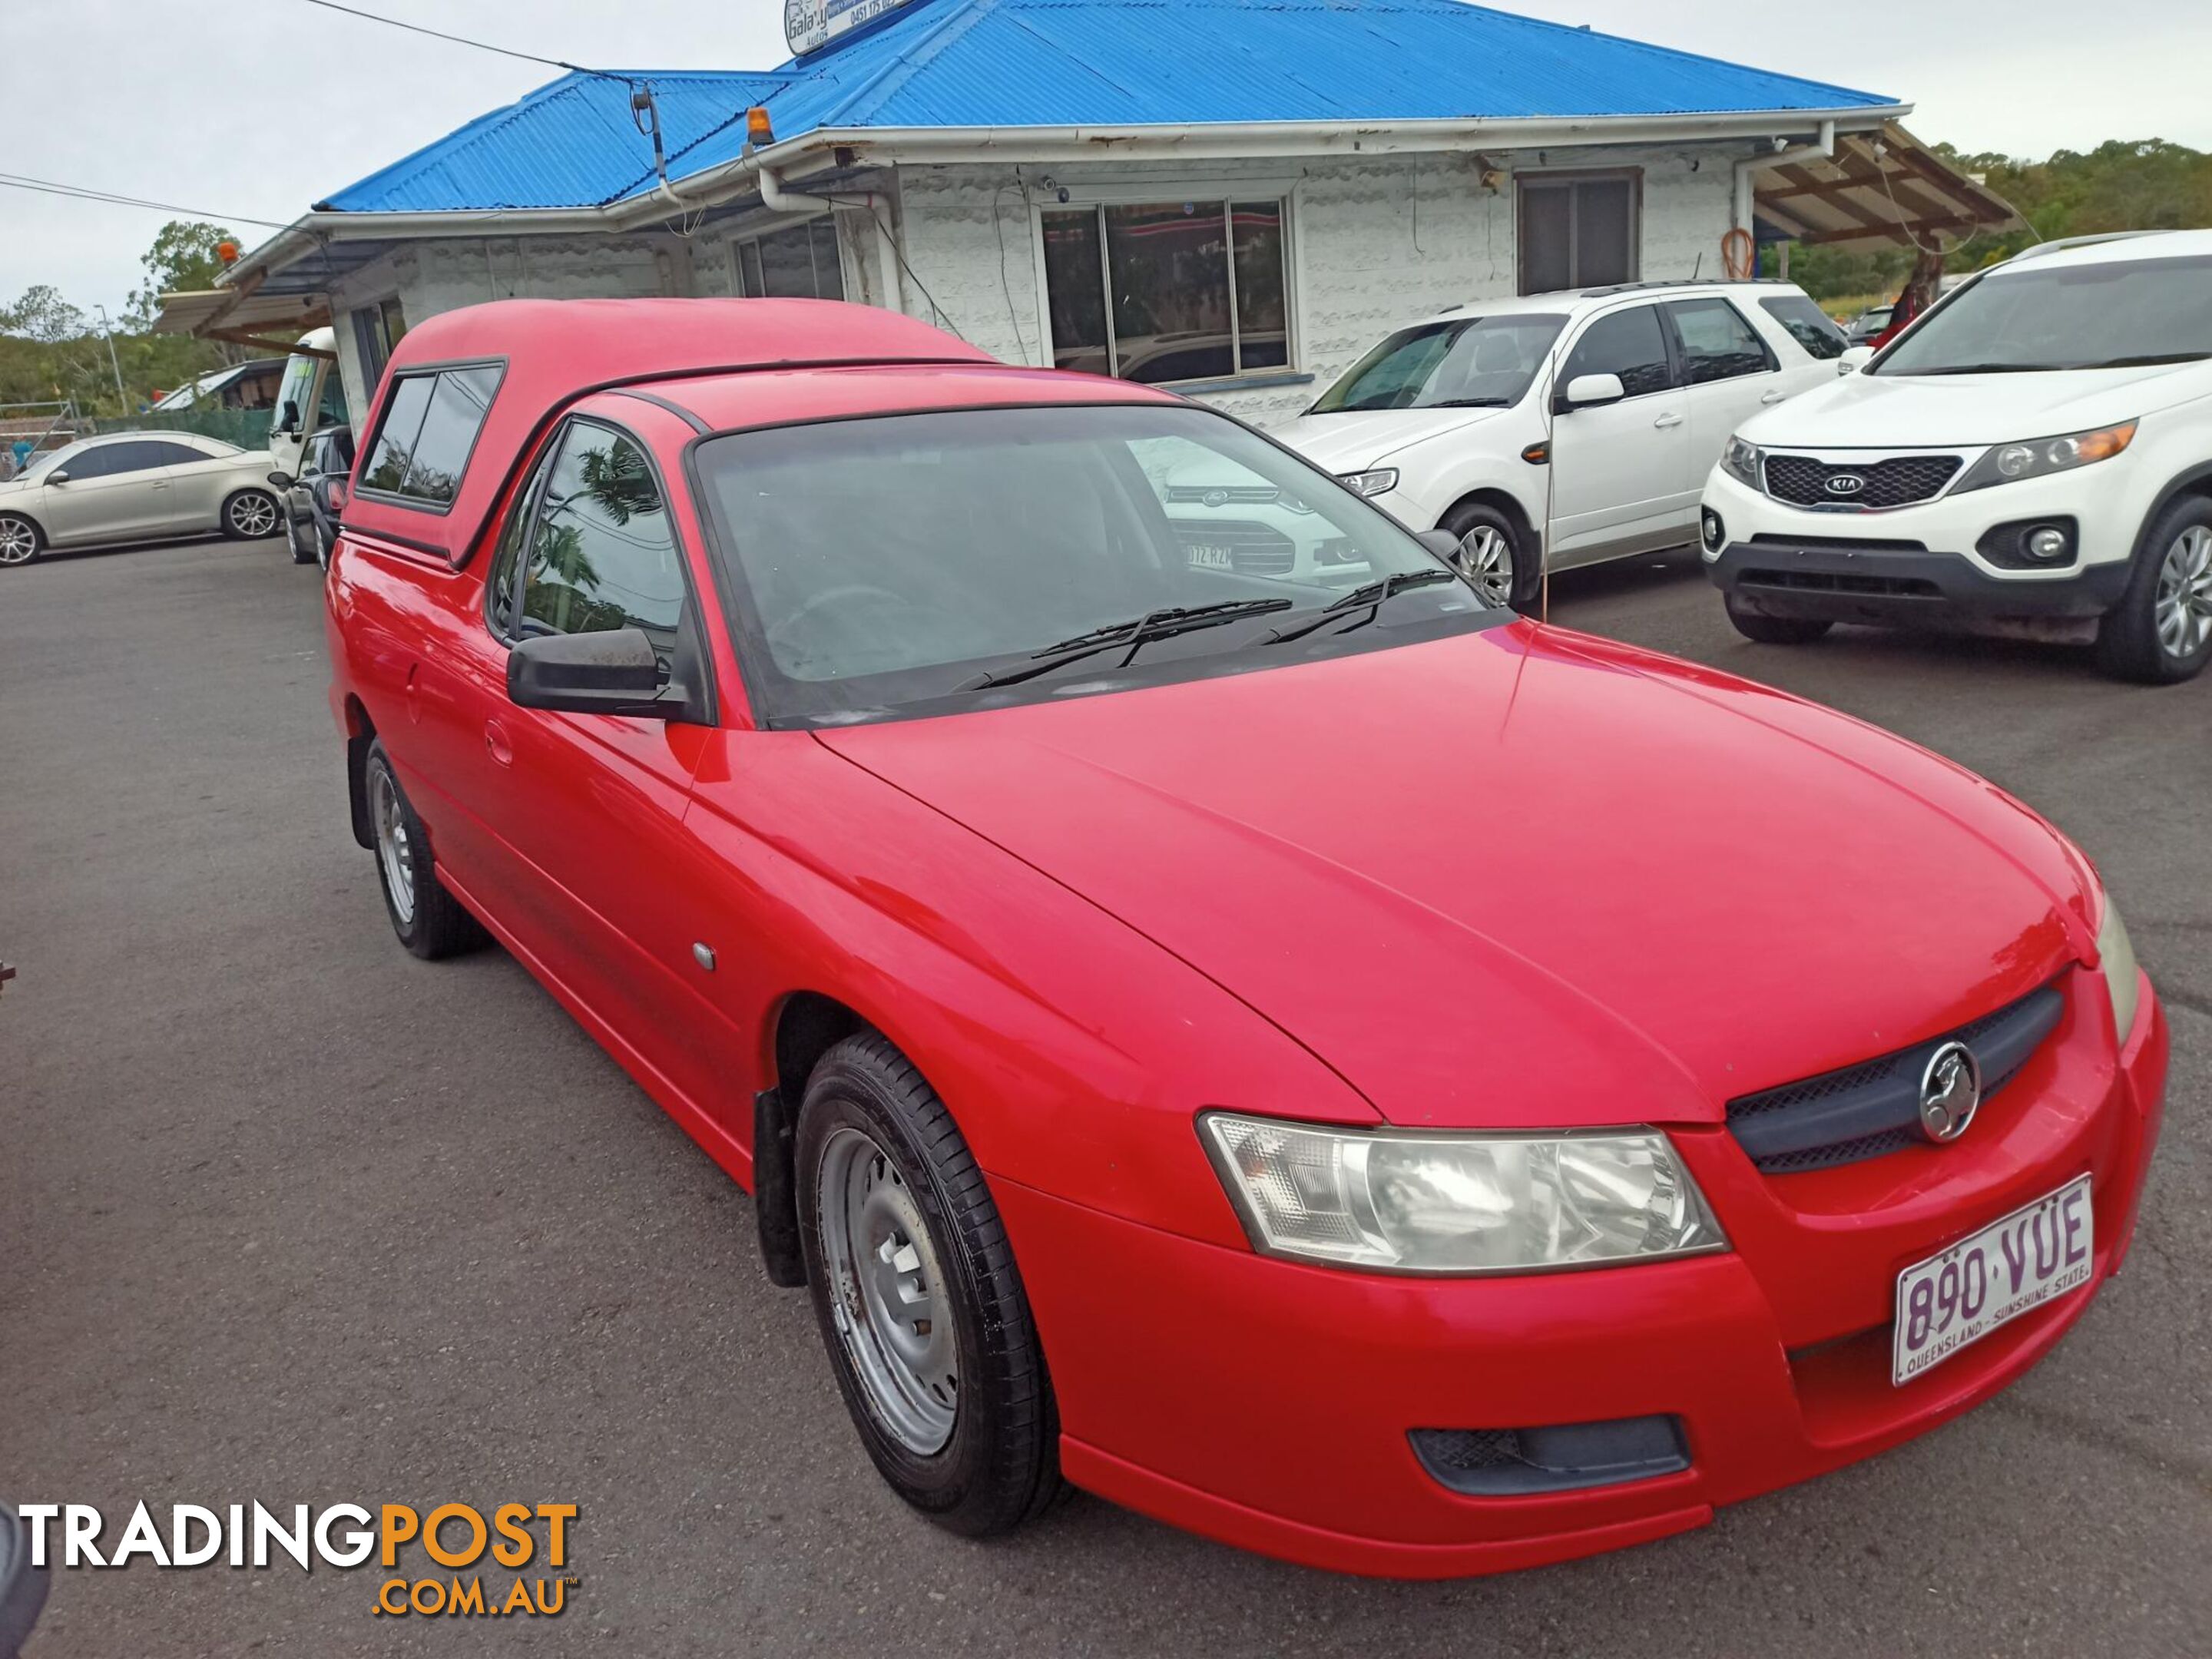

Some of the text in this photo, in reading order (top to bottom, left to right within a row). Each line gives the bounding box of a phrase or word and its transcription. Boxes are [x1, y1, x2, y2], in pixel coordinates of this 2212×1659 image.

[790, 7, 827, 40] Galaxy
[851, 5, 867, 25] 0451
[869, 1, 880, 16] 175
[1833, 479, 1856, 490] KIA
[1907, 1321, 1982, 1374] QUEENSLAND
[1993, 1286, 2048, 1321] SUNSHINE
[2054, 1264, 2085, 1293] STATE
